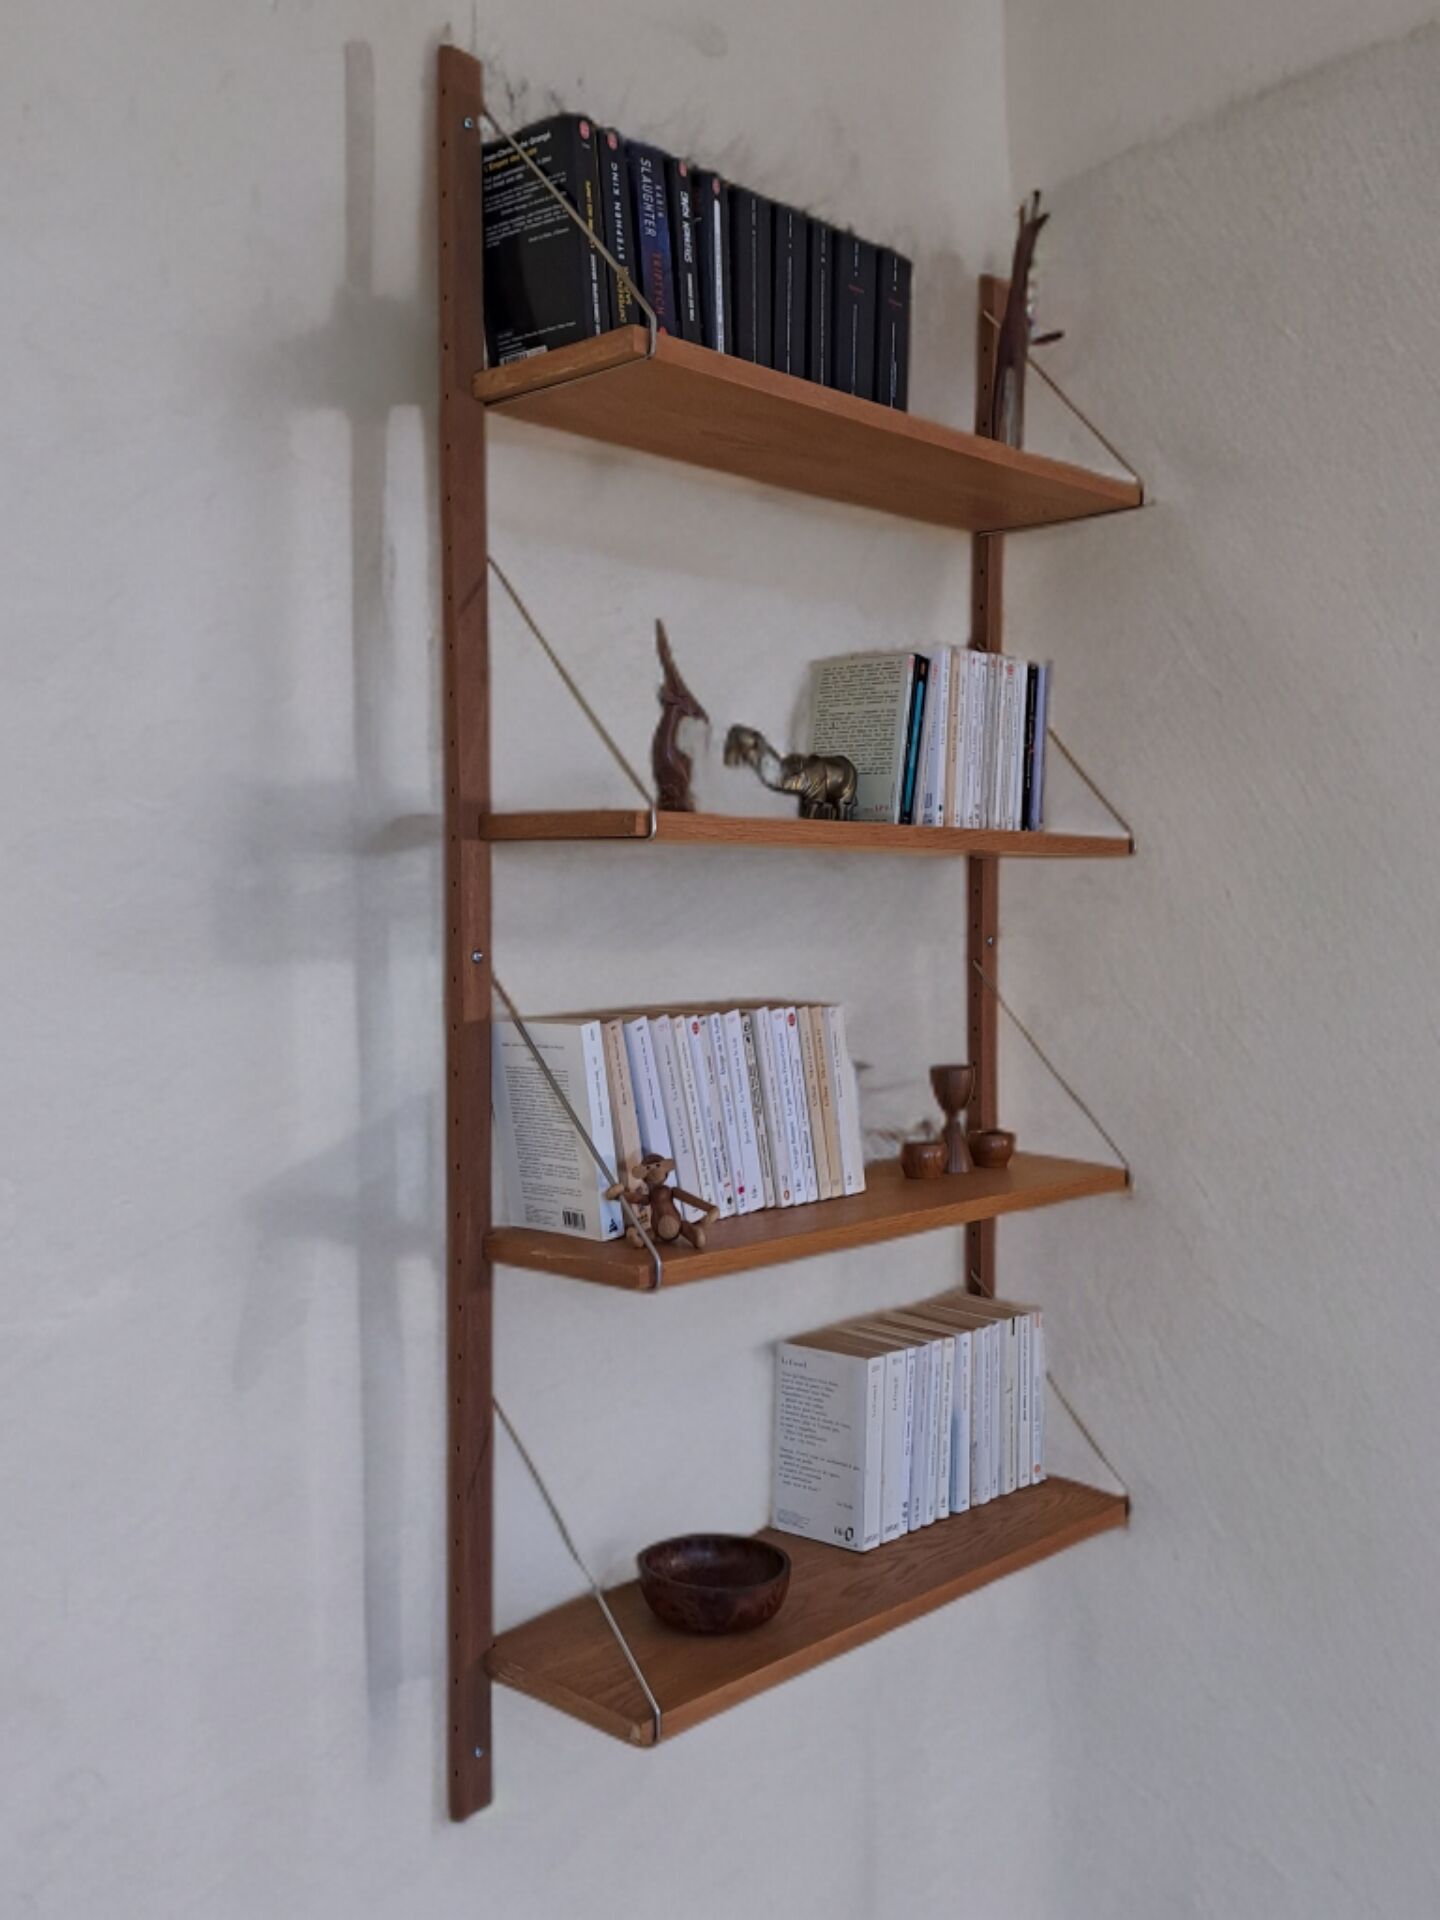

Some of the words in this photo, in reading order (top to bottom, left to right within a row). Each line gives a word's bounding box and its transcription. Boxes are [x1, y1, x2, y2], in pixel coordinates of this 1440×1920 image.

[611, 161, 620, 196] KING
[640, 157, 657, 238] SLAUGHTER
[655, 184, 664, 218] KARIN
[613, 202, 625, 260] STEPHEN
